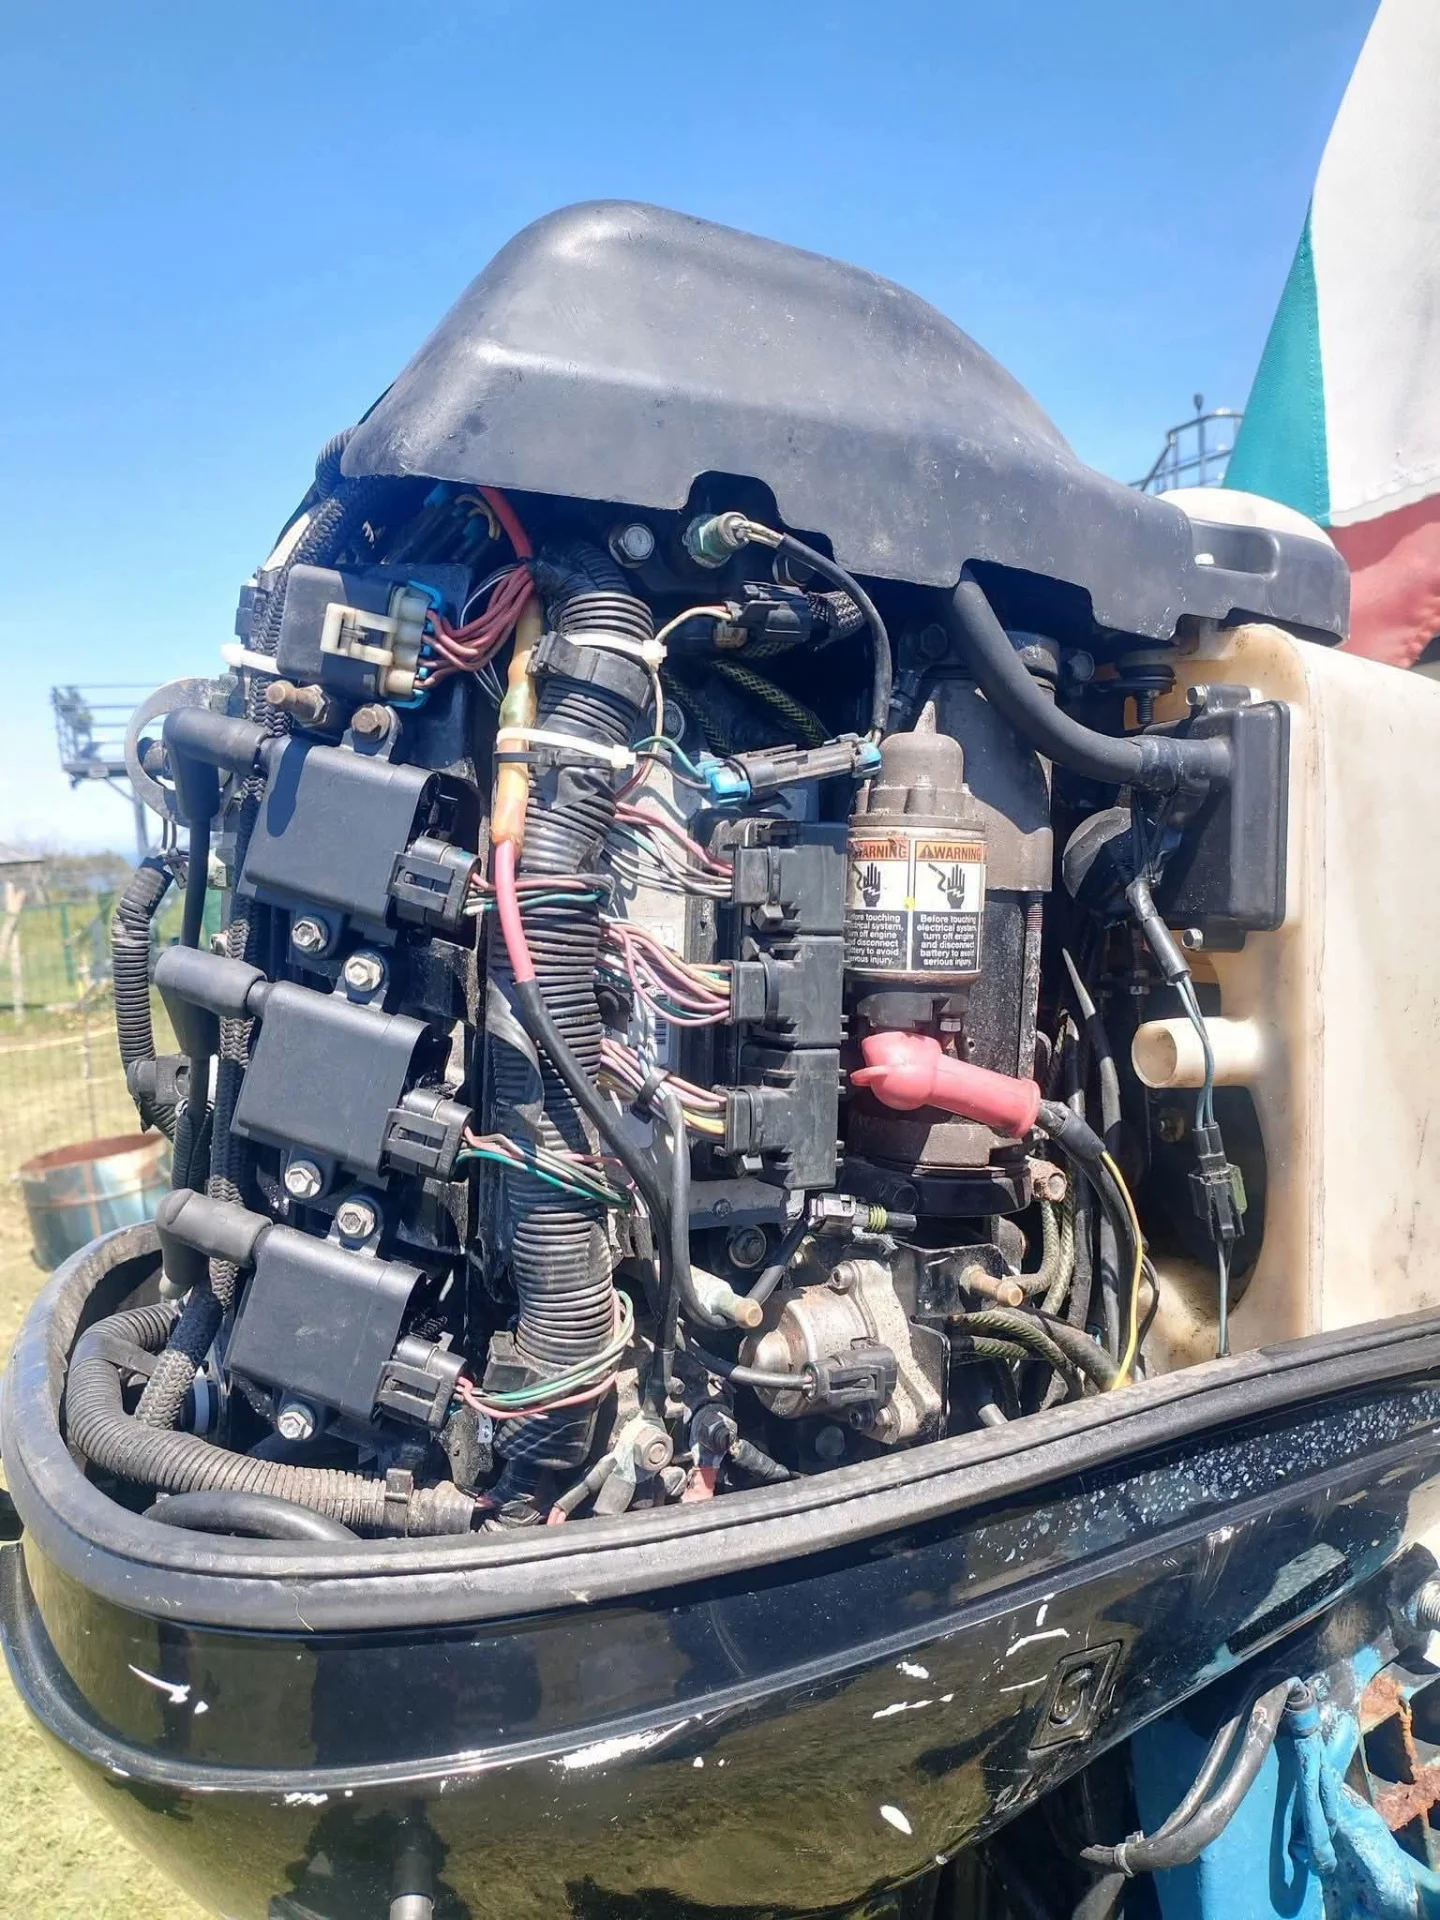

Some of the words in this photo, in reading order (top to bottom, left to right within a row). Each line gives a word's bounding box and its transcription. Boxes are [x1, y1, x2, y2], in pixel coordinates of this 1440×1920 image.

[933, 845, 981, 861] WARNING
[866, 913, 900, 924] touching
[920, 914, 948, 923] Before
[950, 915, 976, 925] touching
[871, 922, 904, 932] system,
[916, 923, 955, 932] electrical
[859, 930, 868, 938] off
[870, 930, 897, 940] engine
[922, 932, 940, 940] turn
[942, 932, 953, 940] off
[856, 939, 899, 948] disconnect
[920, 940, 938, 949] and
[939, 941, 975, 949] disconnect
[866, 947, 875, 955] to
[876, 948, 900, 956] avoid
[920, 949, 950, 958] battery
[951, 949, 959, 957] to
[870, 955, 895, 965] injury.
[923, 958, 954, 966] serious
